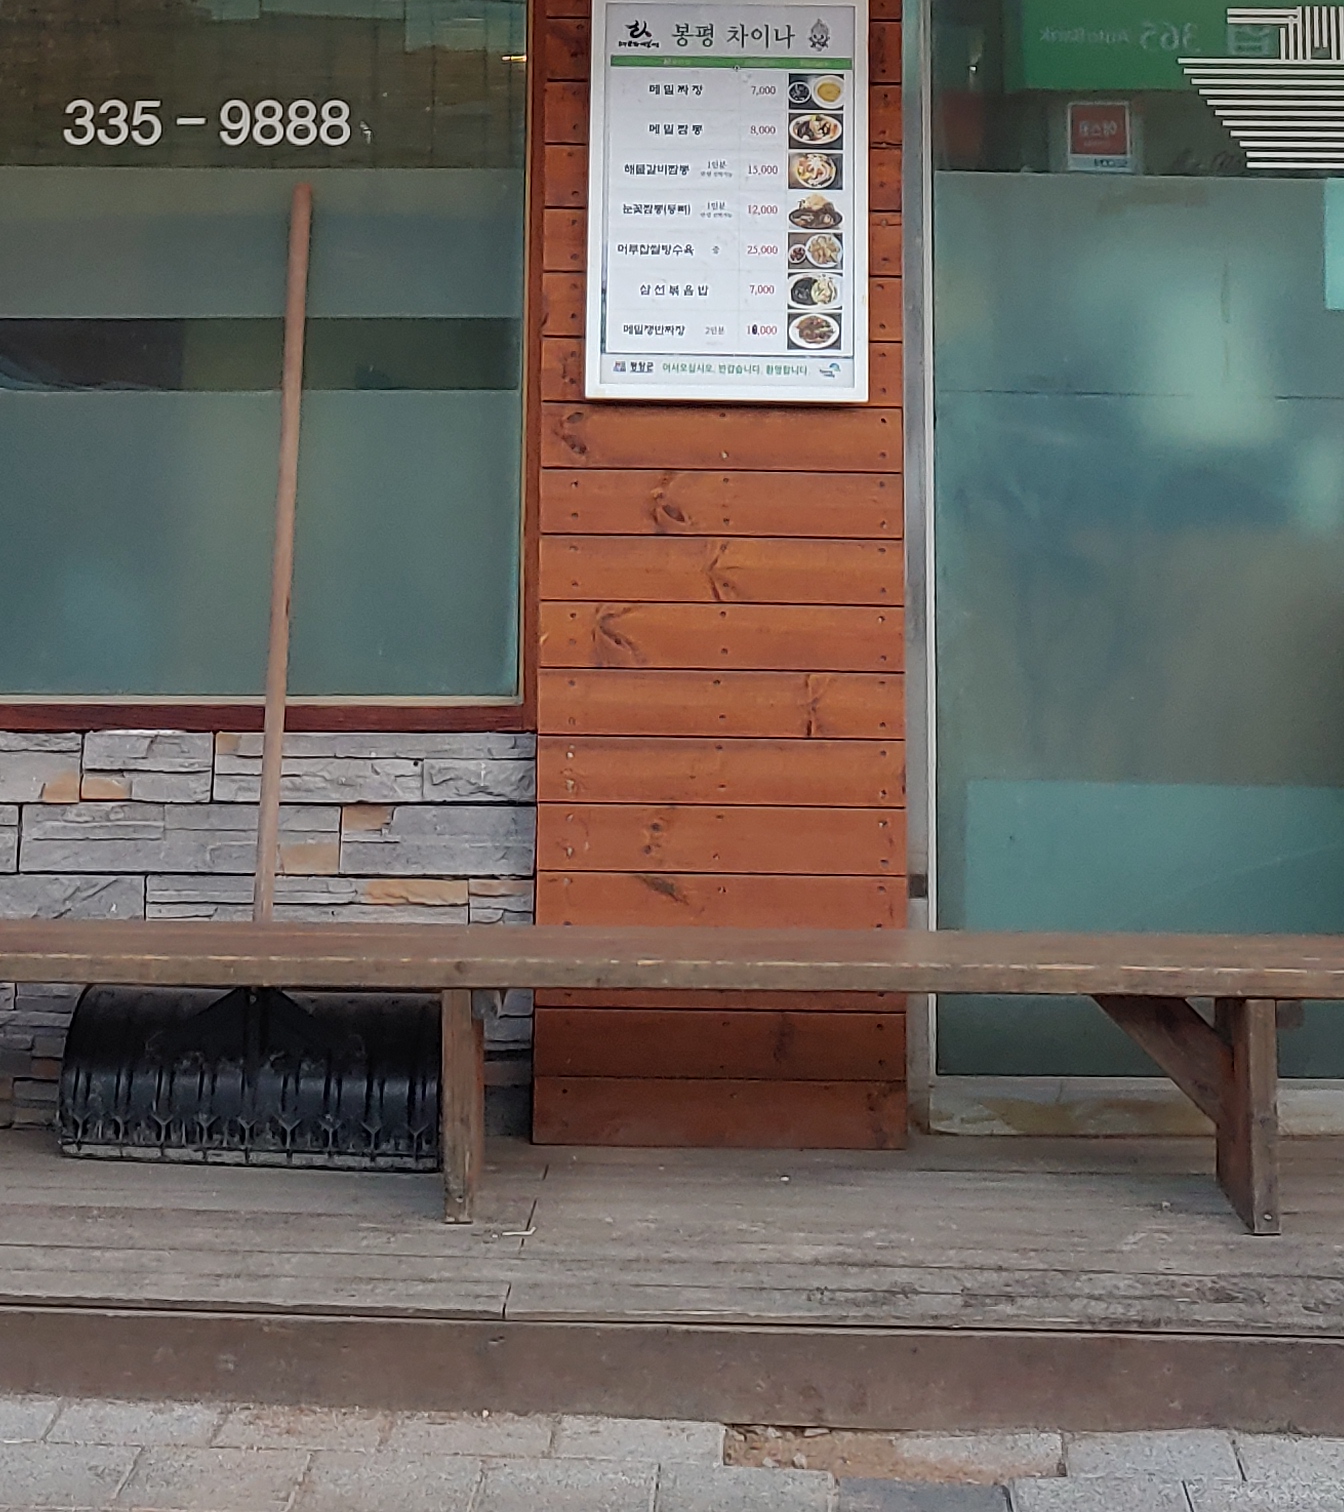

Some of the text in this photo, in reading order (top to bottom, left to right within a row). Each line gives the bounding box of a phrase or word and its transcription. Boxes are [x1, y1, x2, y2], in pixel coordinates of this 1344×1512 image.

[672, 23, 797, 50] 봉평 차이나
[648, 84, 777, 97] 메밀짜장 7,000
[750, 124, 777, 136] 8,000
[747, 164, 779, 176] 15,000
[747, 204, 779, 216] 12,000
[747, 244, 779, 256] 25,000
[749, 284, 776, 296] 7,000
